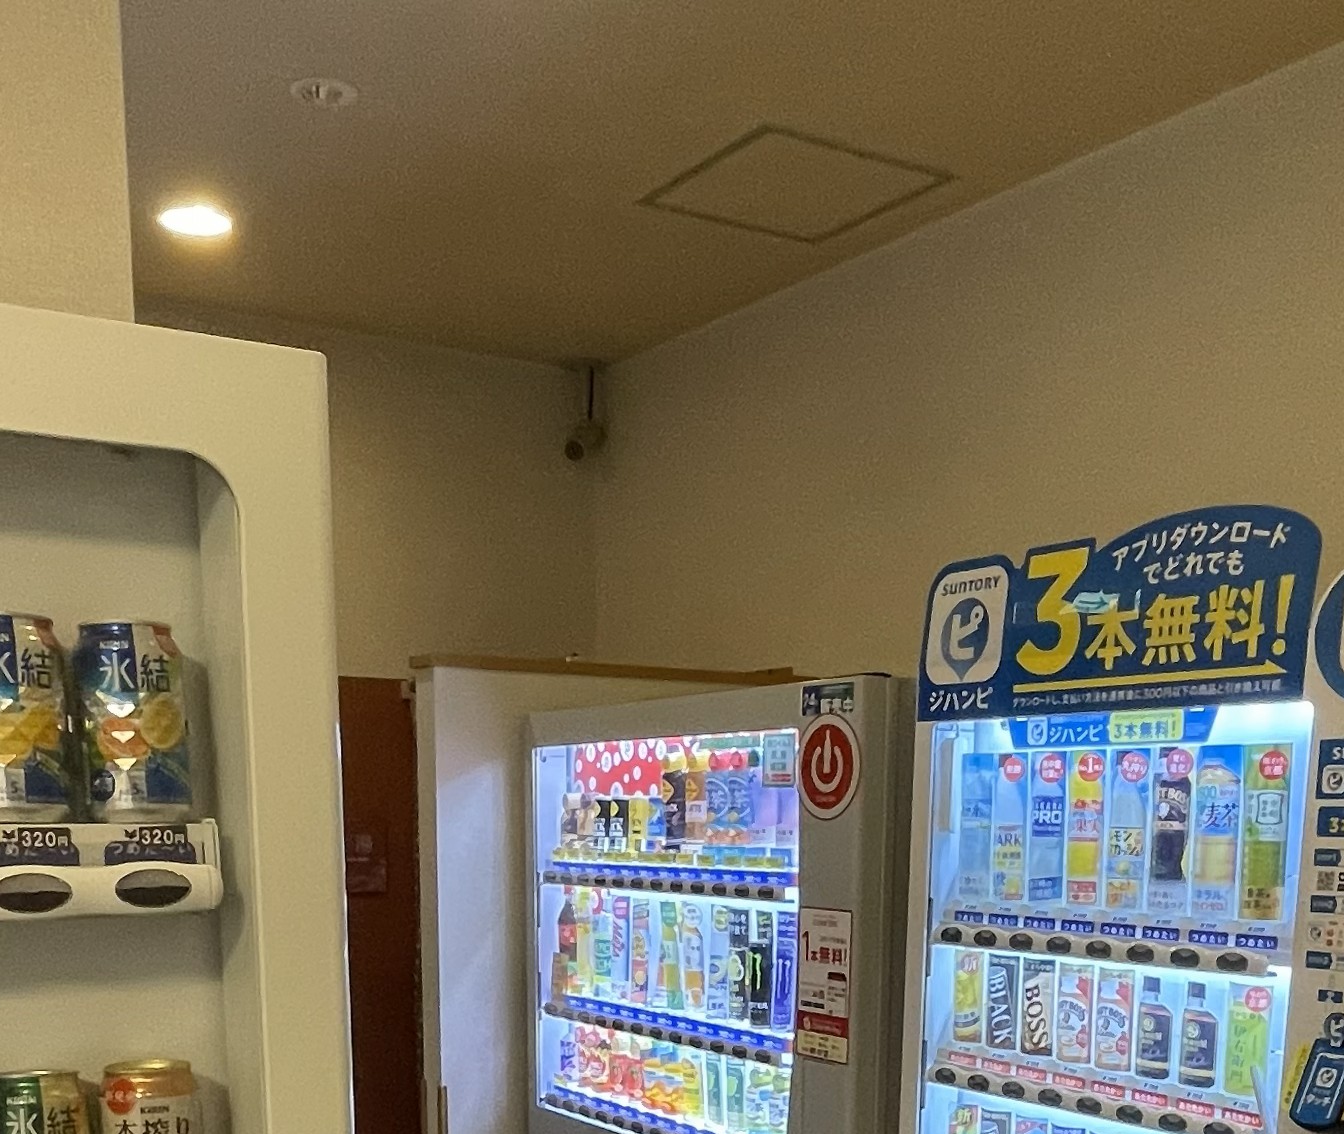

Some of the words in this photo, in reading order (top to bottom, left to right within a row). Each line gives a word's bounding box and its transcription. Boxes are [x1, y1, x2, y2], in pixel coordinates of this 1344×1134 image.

[1111, 519, 1292, 572] アプリダウンロード
[1142, 548, 1245, 585] でどれでも
[942, 574, 1001, 598] SUNTORY
[100, 650, 171, 693] 氷結
[929, 684, 994, 712] ジハンピ
[1048, 724, 1104, 743] ジハンピ
[1032, 809, 1063, 825] PRO
[988, 972, 1013, 1045] BLACK
[1024, 983, 1049, 1049] BOSS
